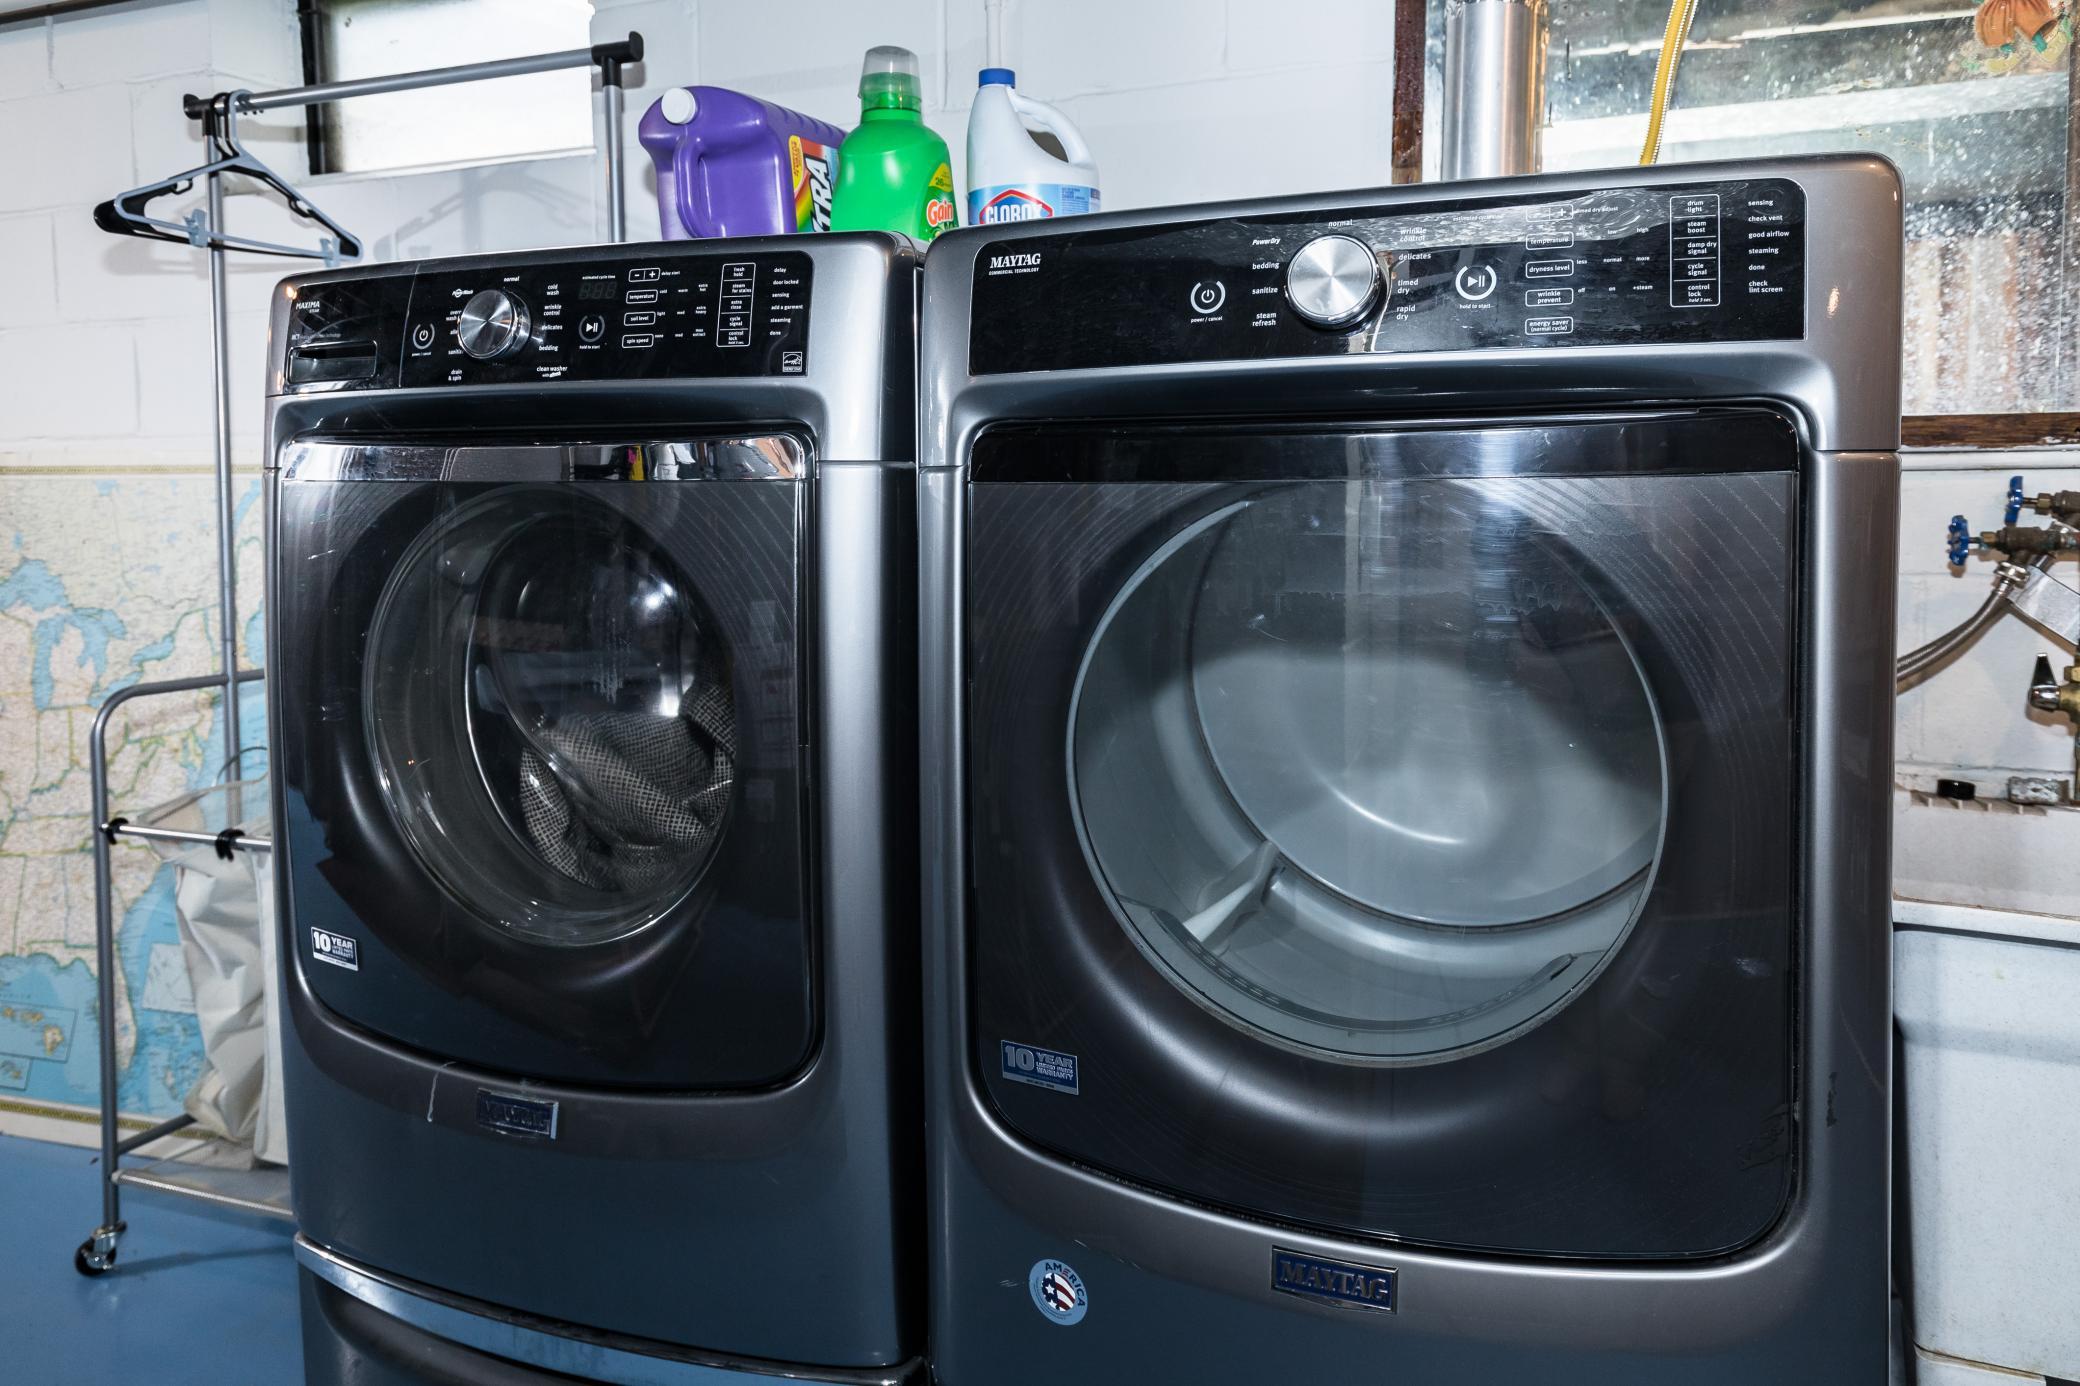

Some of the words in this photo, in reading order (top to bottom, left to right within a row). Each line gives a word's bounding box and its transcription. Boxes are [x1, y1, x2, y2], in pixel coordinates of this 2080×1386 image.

[1748, 199, 1773, 207] sensing
[927, 199, 954, 227] Gain
[1328, 219, 1353, 227] normal
[1252, 237, 1281, 246] PowerDry
[1530, 236, 1569, 245] temperature
[1706, 241, 1717, 249] dry
[1748, 247, 1779, 255] steaming
[1398, 252, 1432, 260] delicates
[990, 253, 1041, 269] MAYTAG
[1252, 261, 1280, 270] bedding
[1252, 286, 1278, 295] sanitize
[1397, 287, 1410, 295] dry
[295, 300, 321, 310] MAXIMA
[1396, 304, 1416, 313] rapid
[1256, 312, 1277, 320] steam
[1396, 313, 1408, 321] dry
[541, 323, 563, 331] delicates
[1252, 319, 1277, 327] refresh
[538, 344, 560, 352] bedding
[549, 364, 568, 372] washer
[313, 931, 332, 953] 10
[331, 936, 353, 950] YEAR
[1004, 1045, 1035, 1071] 10
[1036, 1052, 1073, 1069] YEAR
[1280, 1260, 1389, 1299] MAYTAG
[1045, 1262, 1086, 1306] AMERICA
